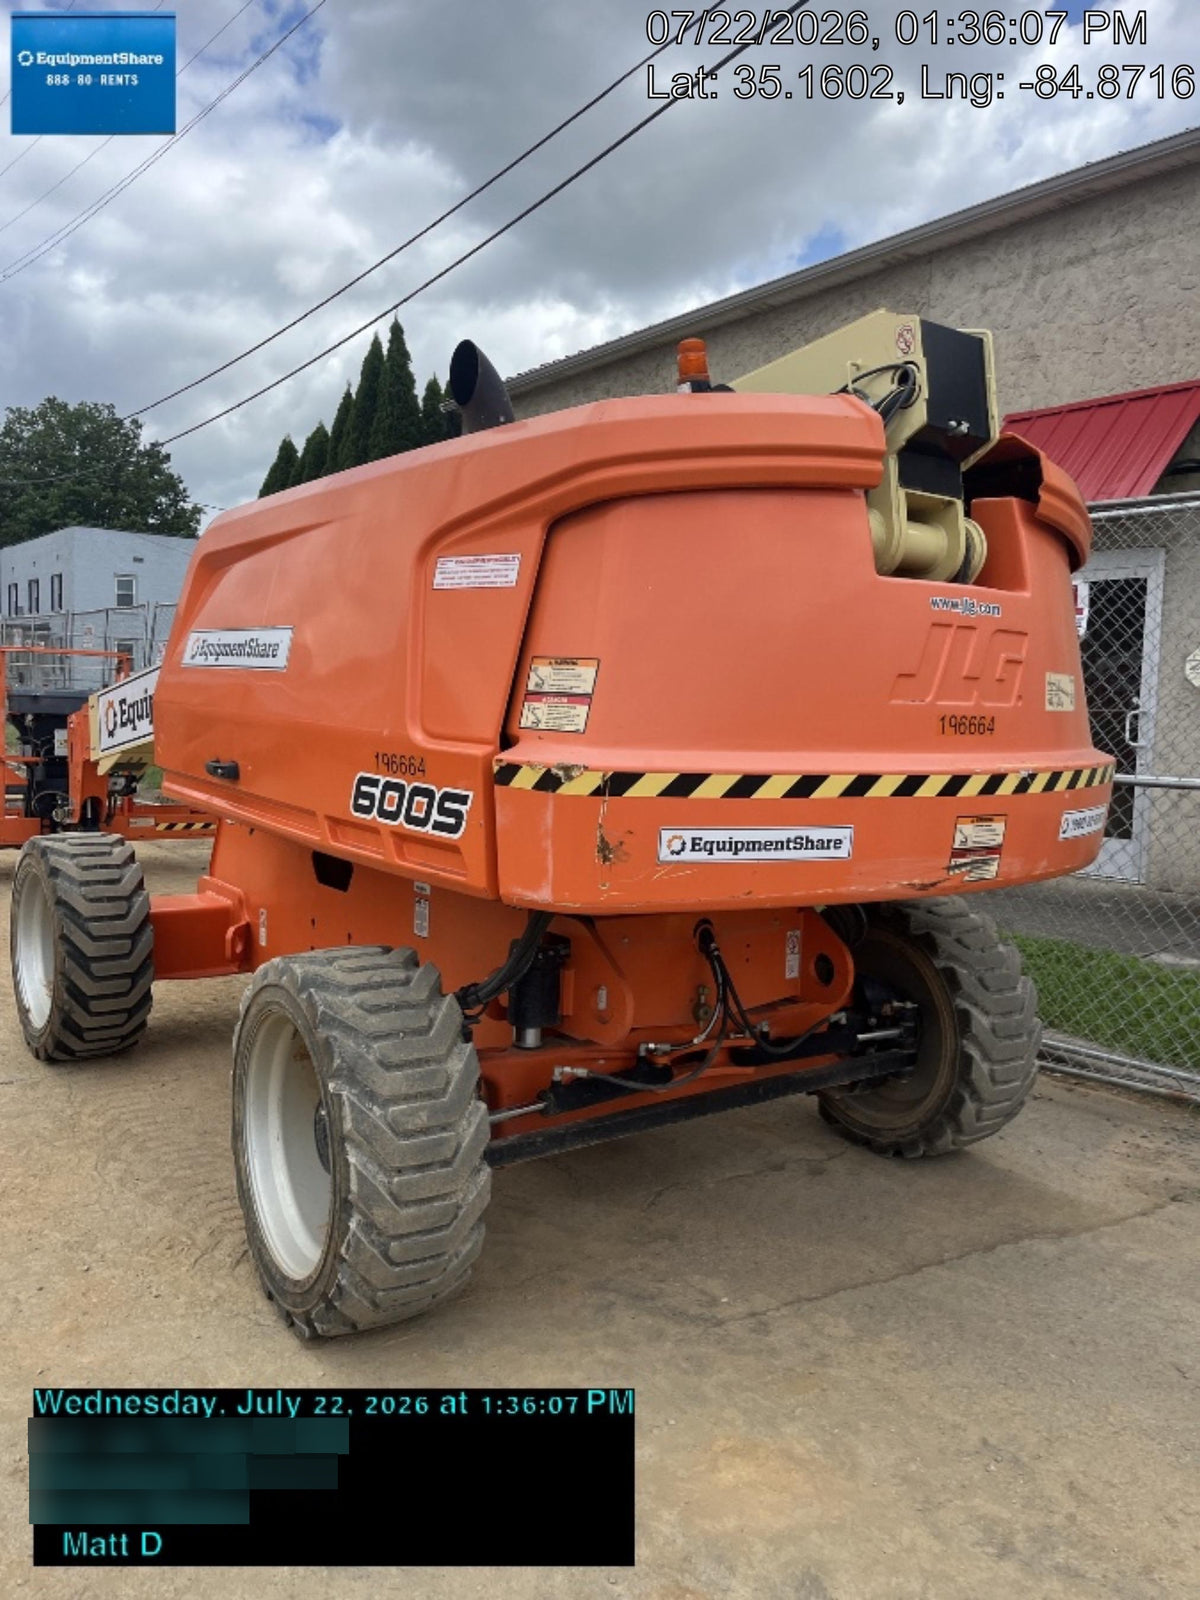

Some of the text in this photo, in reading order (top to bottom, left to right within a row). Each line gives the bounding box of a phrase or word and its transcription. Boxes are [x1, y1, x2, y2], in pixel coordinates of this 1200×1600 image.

[889, 622, 1029, 706] JLG
[938, 714, 996, 735] 196664
[374, 751, 426, 777] 196664
[350, 771, 473, 839] 600S
[690, 835, 844, 856] EquipmentShare
